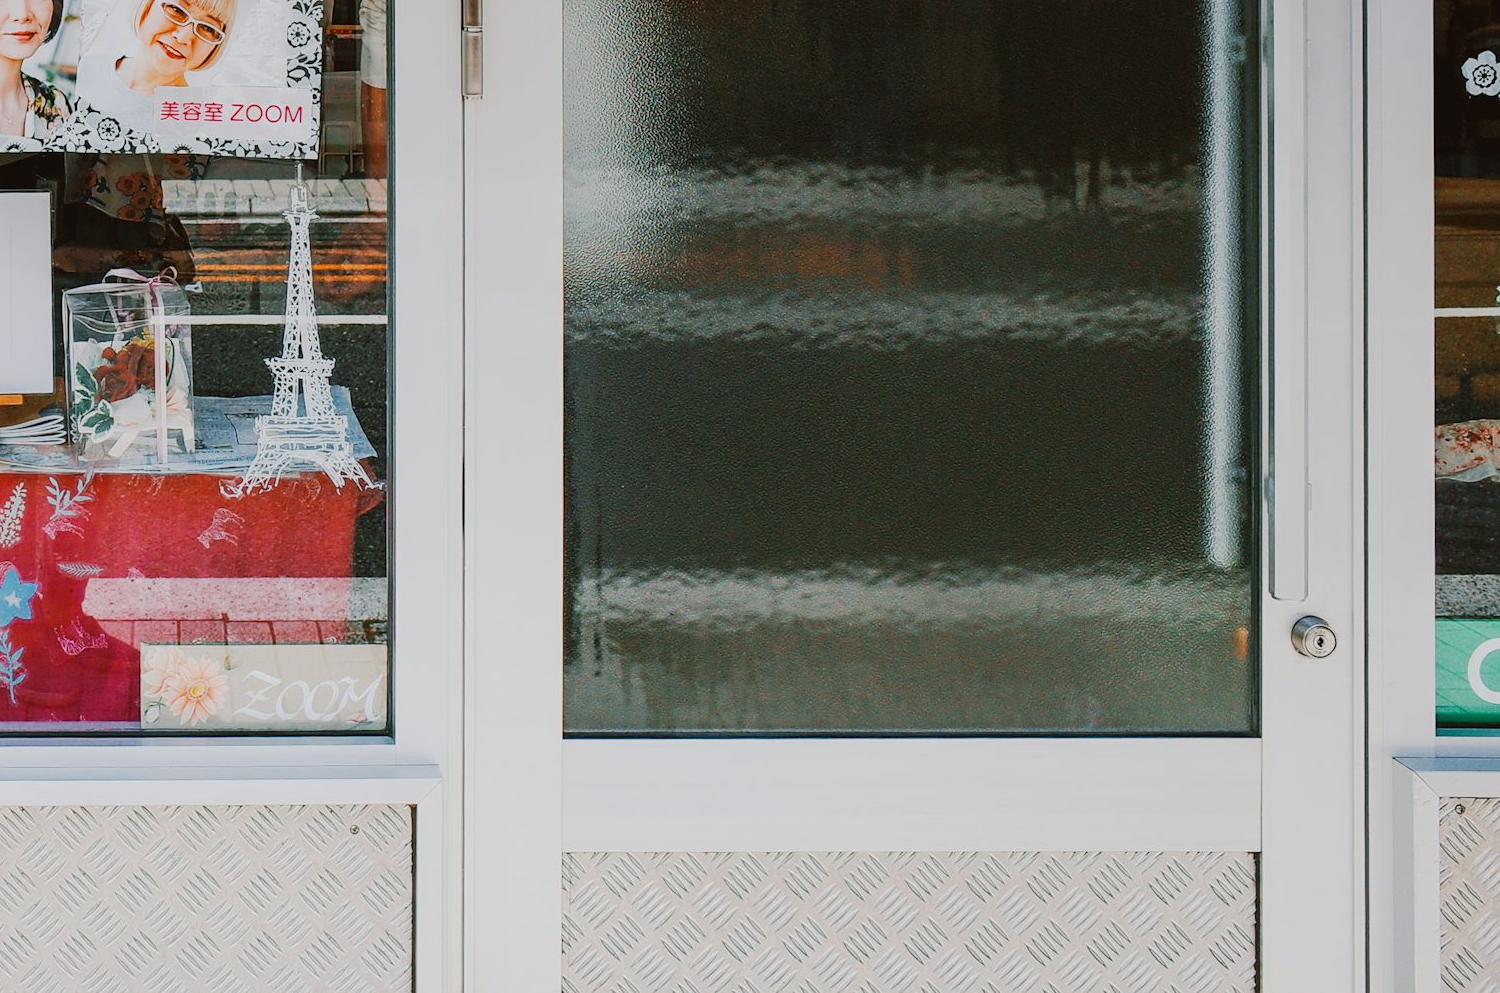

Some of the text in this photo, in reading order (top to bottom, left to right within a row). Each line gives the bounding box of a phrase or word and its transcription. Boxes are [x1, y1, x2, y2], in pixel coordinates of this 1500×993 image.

[159, 101, 303, 124] 美容室 ZOOM
[231, 669, 386, 722] ZOOM
